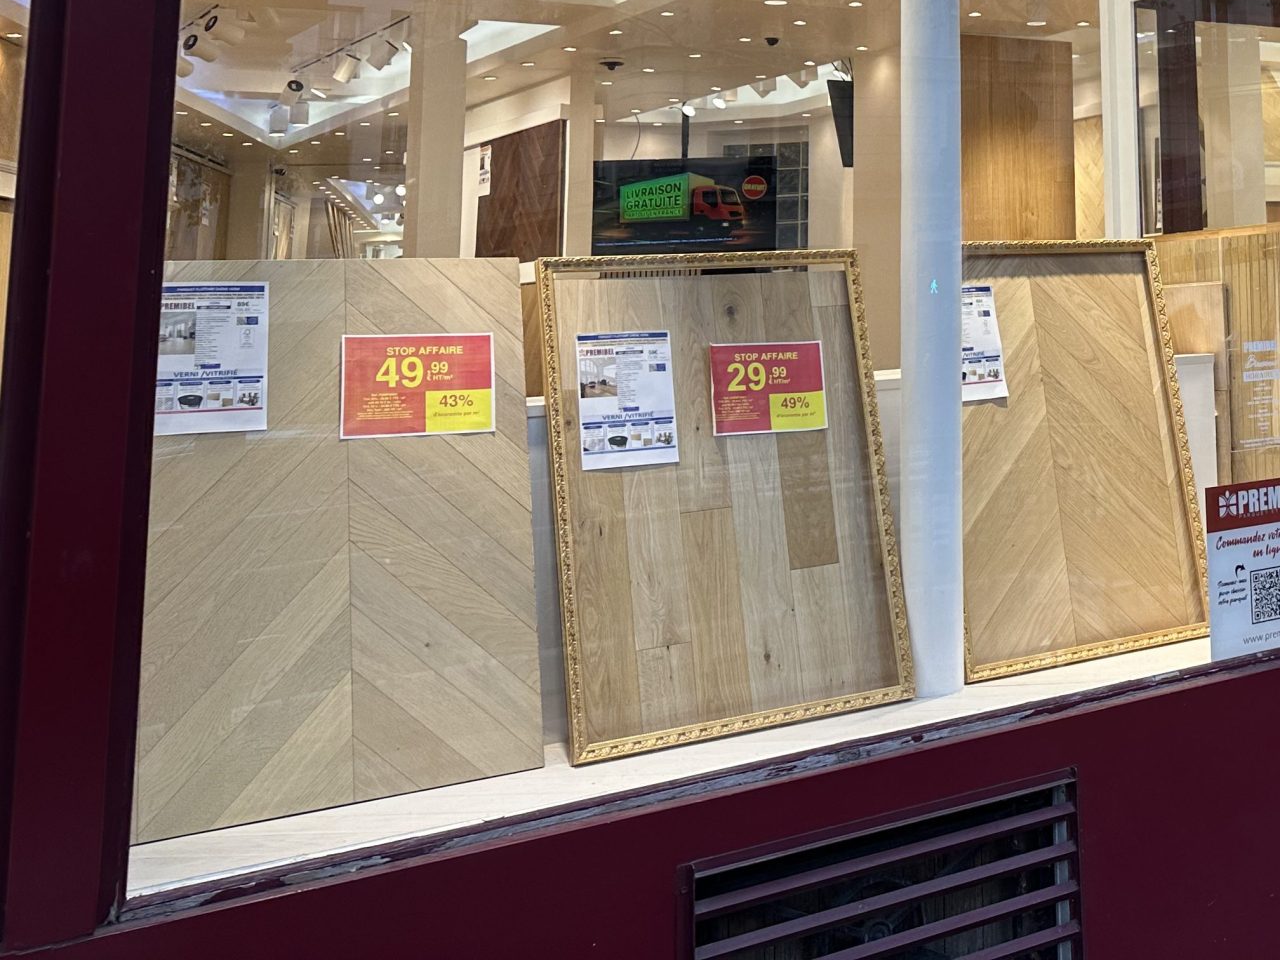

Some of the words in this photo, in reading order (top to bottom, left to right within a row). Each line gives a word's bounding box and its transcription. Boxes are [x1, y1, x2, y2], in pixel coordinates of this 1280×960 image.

[626, 182, 682, 199] LIVRAISON
[626, 195, 681, 210] GRATUITE
[161, 302, 196, 310] PREMIBEL
[386, 346, 416, 356] STOP
[418, 345, 464, 355] AFFAIRE
[734, 353, 759, 362] STOP
[761, 351, 799, 361] AFFAIRE
[375, 356, 424, 388] 49
[726, 362, 767, 392] 29
[439, 394, 474, 408] 43%
[781, 395, 810, 409] 49%
[1216, 531, 1267, 551] Commandez
[1253, 549, 1264, 558] en
